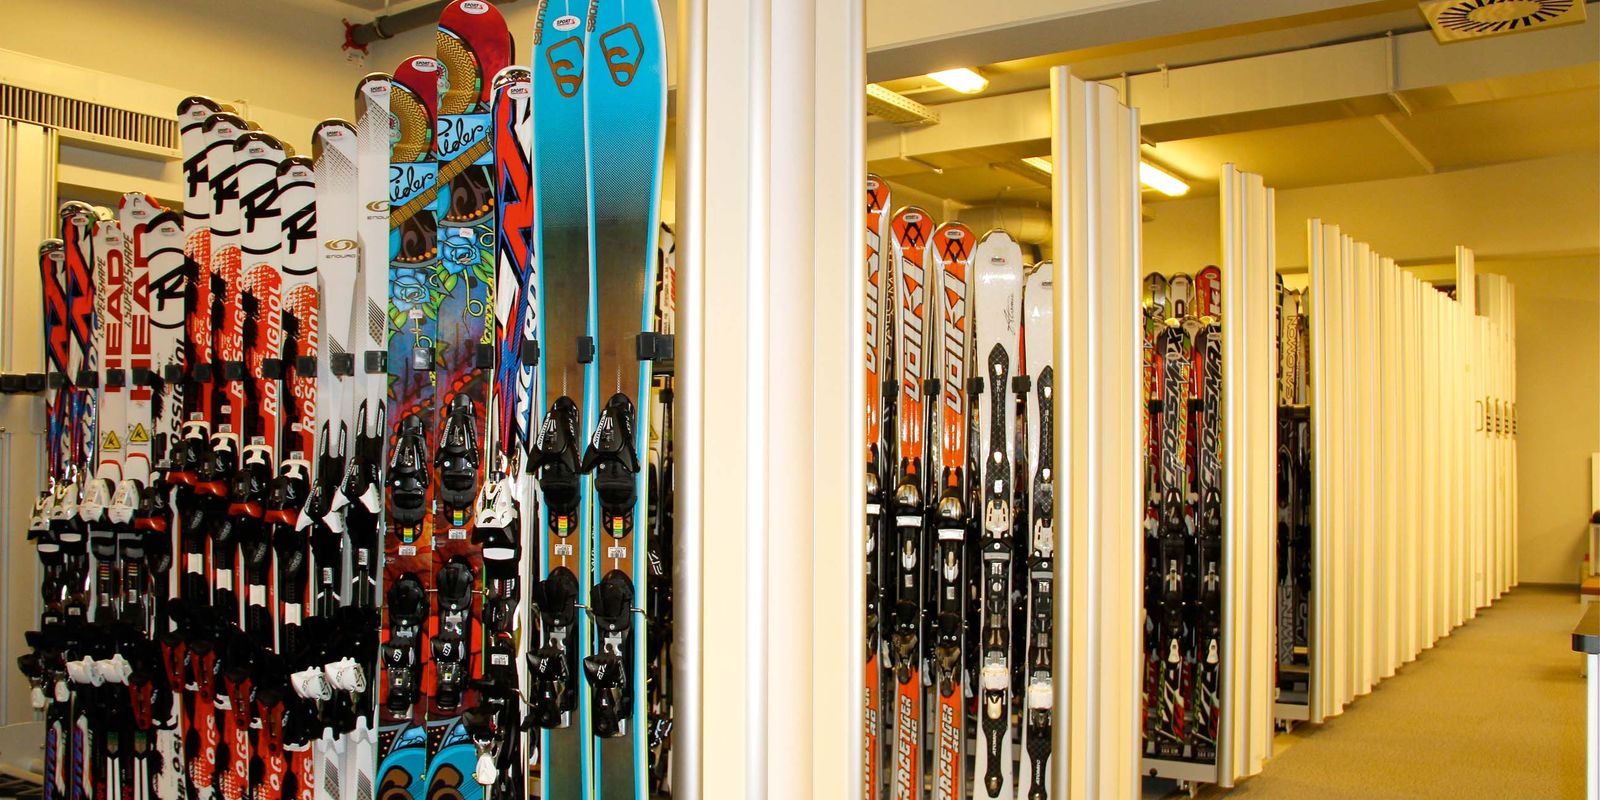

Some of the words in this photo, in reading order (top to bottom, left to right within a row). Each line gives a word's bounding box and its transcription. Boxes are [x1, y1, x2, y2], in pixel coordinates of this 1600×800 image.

[533, 0, 548, 46] salomo
[105, 249, 124, 392] HEAD
[130, 223, 151, 400] HEAD
[1285, 315, 1298, 401] SALOMON
[910, 719, 918, 745] RC
[952, 727, 959, 753] RC
